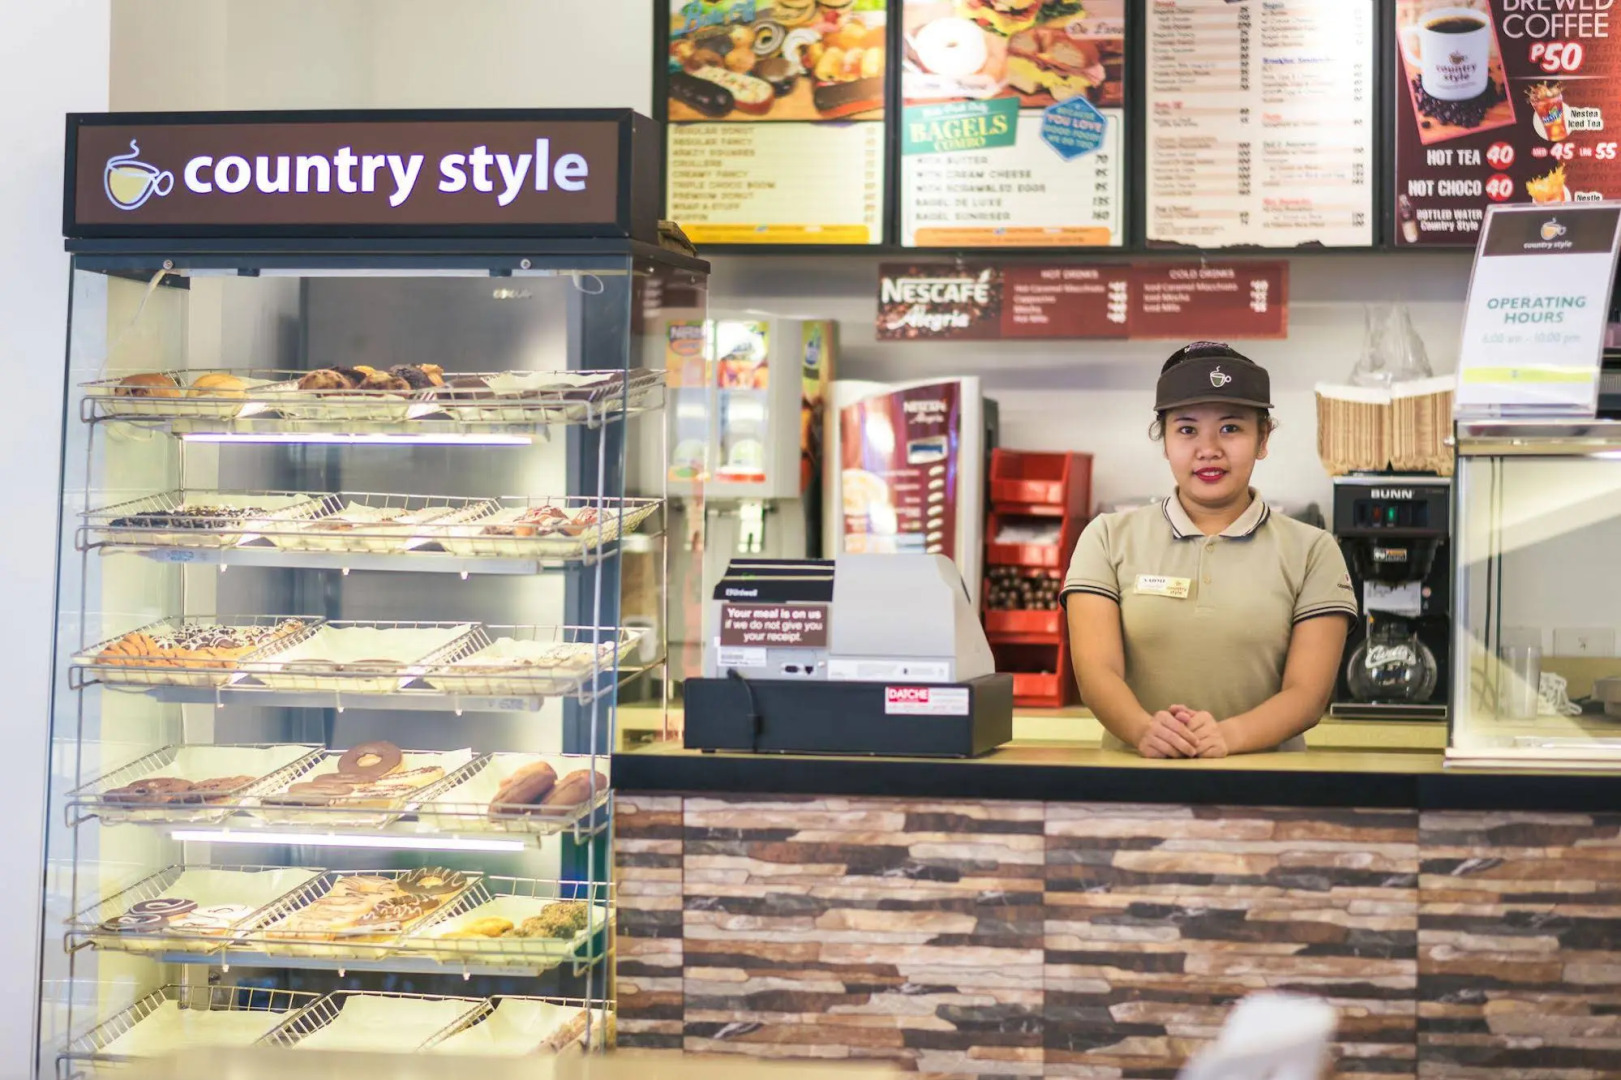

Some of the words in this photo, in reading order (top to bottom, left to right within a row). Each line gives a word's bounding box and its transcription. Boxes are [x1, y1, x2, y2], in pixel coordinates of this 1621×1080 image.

[1503, 13, 1609, 38] COFFEE
[1570, 109, 1599, 118] Nestea
[909, 114, 1009, 143] BAGELS
[1047, 114, 1072, 126] YOU
[1072, 118, 1102, 133] LOVE
[1568, 119, 1585, 128] Iced
[1586, 119, 1601, 128] Tea
[1427, 149, 1453, 166] HOT
[1456, 149, 1481, 166] TEA
[1486, 145, 1514, 164] 40
[1550, 142, 1576, 160] 45
[1595, 142, 1618, 160] 55
[183, 145, 425, 208] country
[438, 137, 590, 207] style
[989, 170, 1032, 178] CHEESE
[1408, 180, 1434, 197] HOT
[1438, 180, 1482, 197] CHOCO
[1485, 178, 1513, 197] 40
[1416, 209, 1452, 220] BOTTLED
[1454, 209, 1483, 220] WATER
[1420, 221, 1455, 232] Country
[1456, 220, 1479, 232] Style
[1523, 242, 1553, 250] country
[1553, 240, 1573, 249] style
[1041, 269, 1061, 279] HOT
[1062, 269, 1099, 280] DRINKS
[1169, 269, 1198, 280] COLD
[1199, 269, 1235, 279] DRINKS
[1487, 296, 1586, 310] OPERATING
[886, 304, 970, 332] Alegria
[1503, 311, 1564, 324] HOURS
[1371, 489, 1413, 499] BUNN
[726, 608, 752, 619] Your
[753, 608, 779, 619] meal
[780, 608, 791, 619] is
[792, 610, 807, 620] on
[808, 610, 822, 620] us
[724, 619, 733, 629] if
[733, 620, 748, 630] we
[749, 620, 763, 630] do
[764, 620, 781, 630] not
[782, 620, 803, 632] give
[804, 621, 824, 633] you
[743, 632, 766, 643] your
